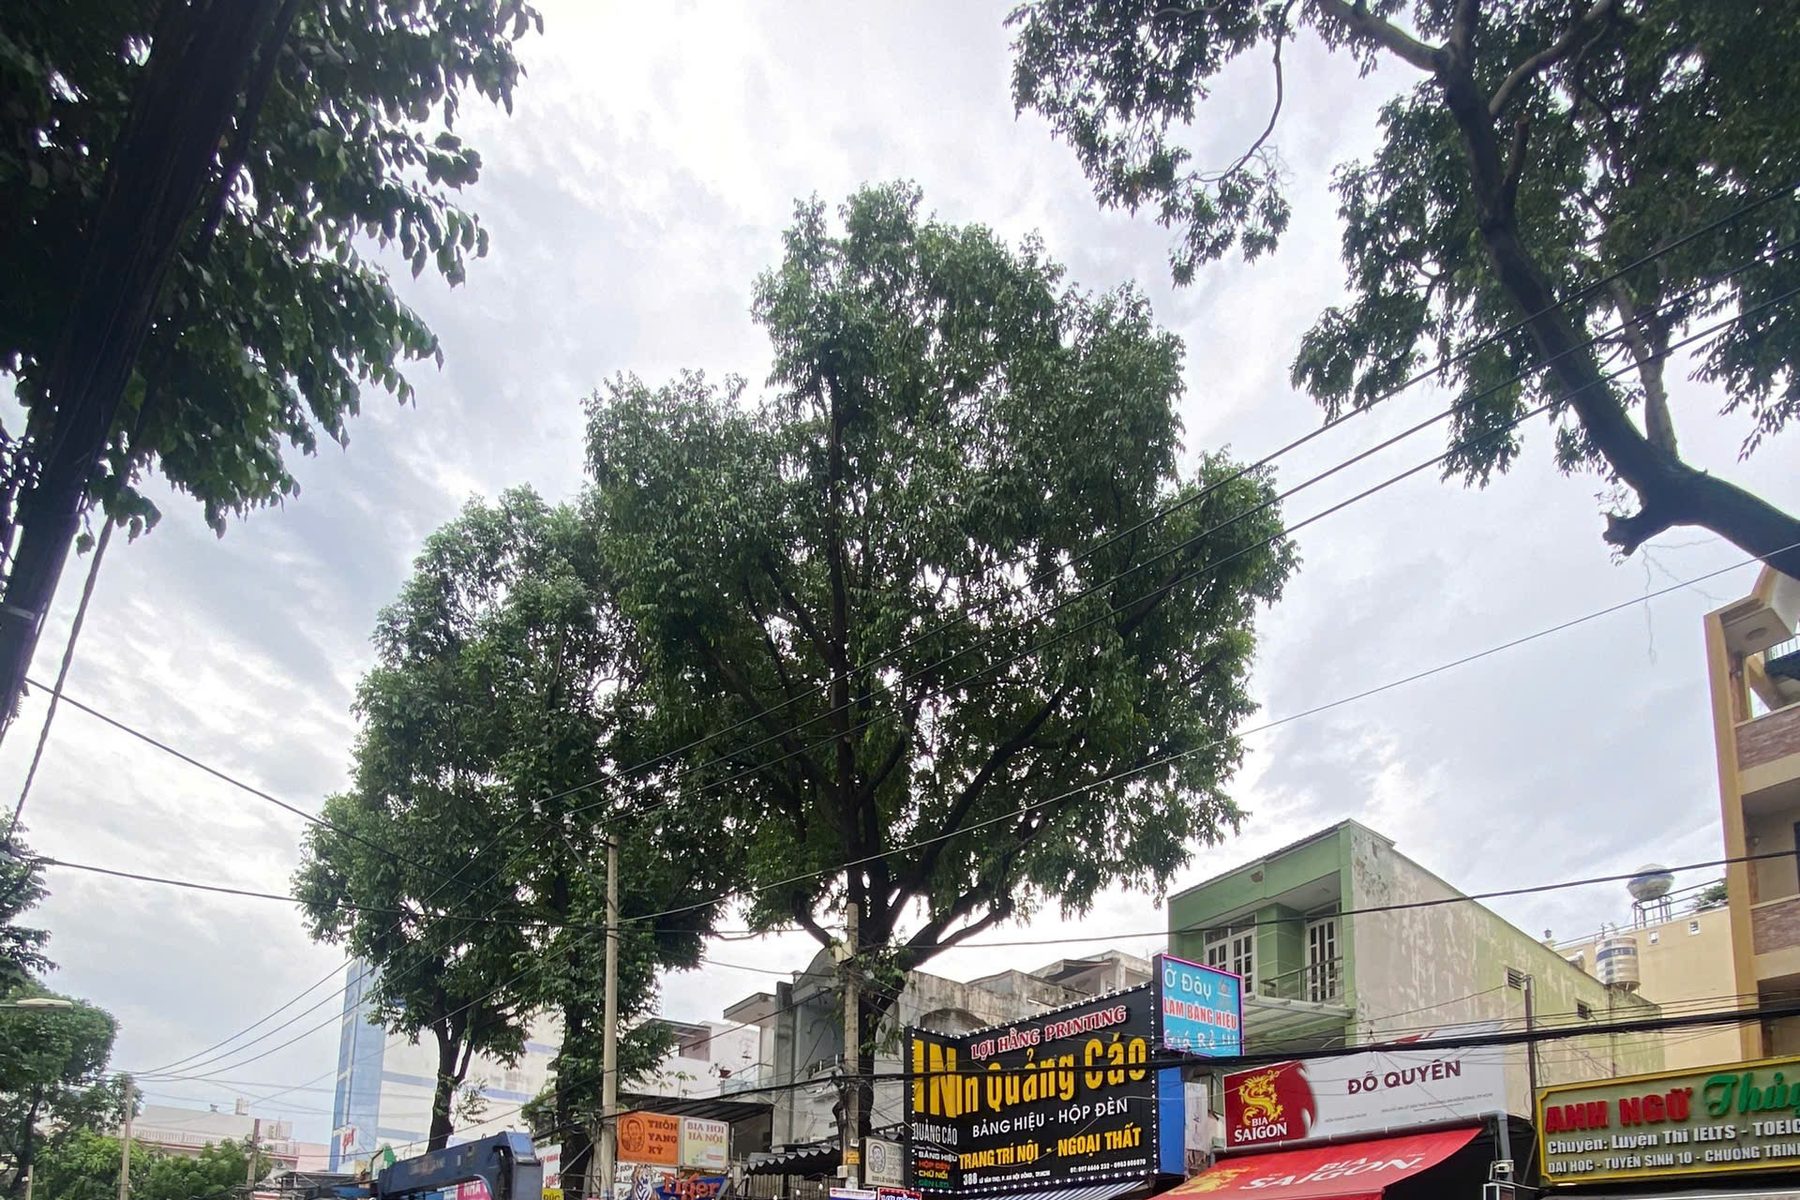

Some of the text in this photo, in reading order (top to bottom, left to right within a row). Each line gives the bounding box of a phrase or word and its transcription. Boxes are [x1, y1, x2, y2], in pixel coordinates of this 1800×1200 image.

[971, 1039, 995, 1061] LỢI
[1044, 1005, 1127, 1042] PRINTING
[913, 1039, 957, 1118] IN
[987, 1048, 1075, 1112] Quảng
[1084, 1032, 1147, 1090] Cáo
[1347, 1059, 1461, 1095] ĐỖ QUYÊN
[648, 1119, 678, 1130] THÔN
[687, 1122, 704, 1131] BIA
[972, 1118, 1011, 1138] BẢNG
[1014, 1111, 1045, 1131] HIỆU
[1058, 1104, 1091, 1124] HỘP
[1095, 1097, 1128, 1117] ĐÈN
[1251, 1116, 1268, 1127] BIA
[1545, 1100, 1609, 1133] ANH
[1619, 1087, 1693, 1127] NGỮ
[913, 1119, 958, 1146] QUẢNG CÁO
[960, 1151, 995, 1170] TRANG
[996, 1142, 1015, 1165] TRÍ
[1017, 1140, 1039, 1164] NỘI
[1057, 1133, 1100, 1157] NGOẠI
[1104, 1122, 1142, 1151] THẤT
[1547, 1138, 1608, 1155] Chuyên:
[1611, 1132, 1658, 1150] Luyện
[1662, 1129, 1688, 1144] Thi
[1693, 1124, 1736, 1141] IELTS
[1239, 1157, 1425, 1190] SAIGON
[1315, 1158, 1367, 1172] BIA
[1548, 1161, 1567, 1176] ĐẠI
[1570, 1159, 1593, 1174] HỌC
[1645, 1153, 1674, 1167] SINH
[1678, 1151, 1692, 1164] 10
